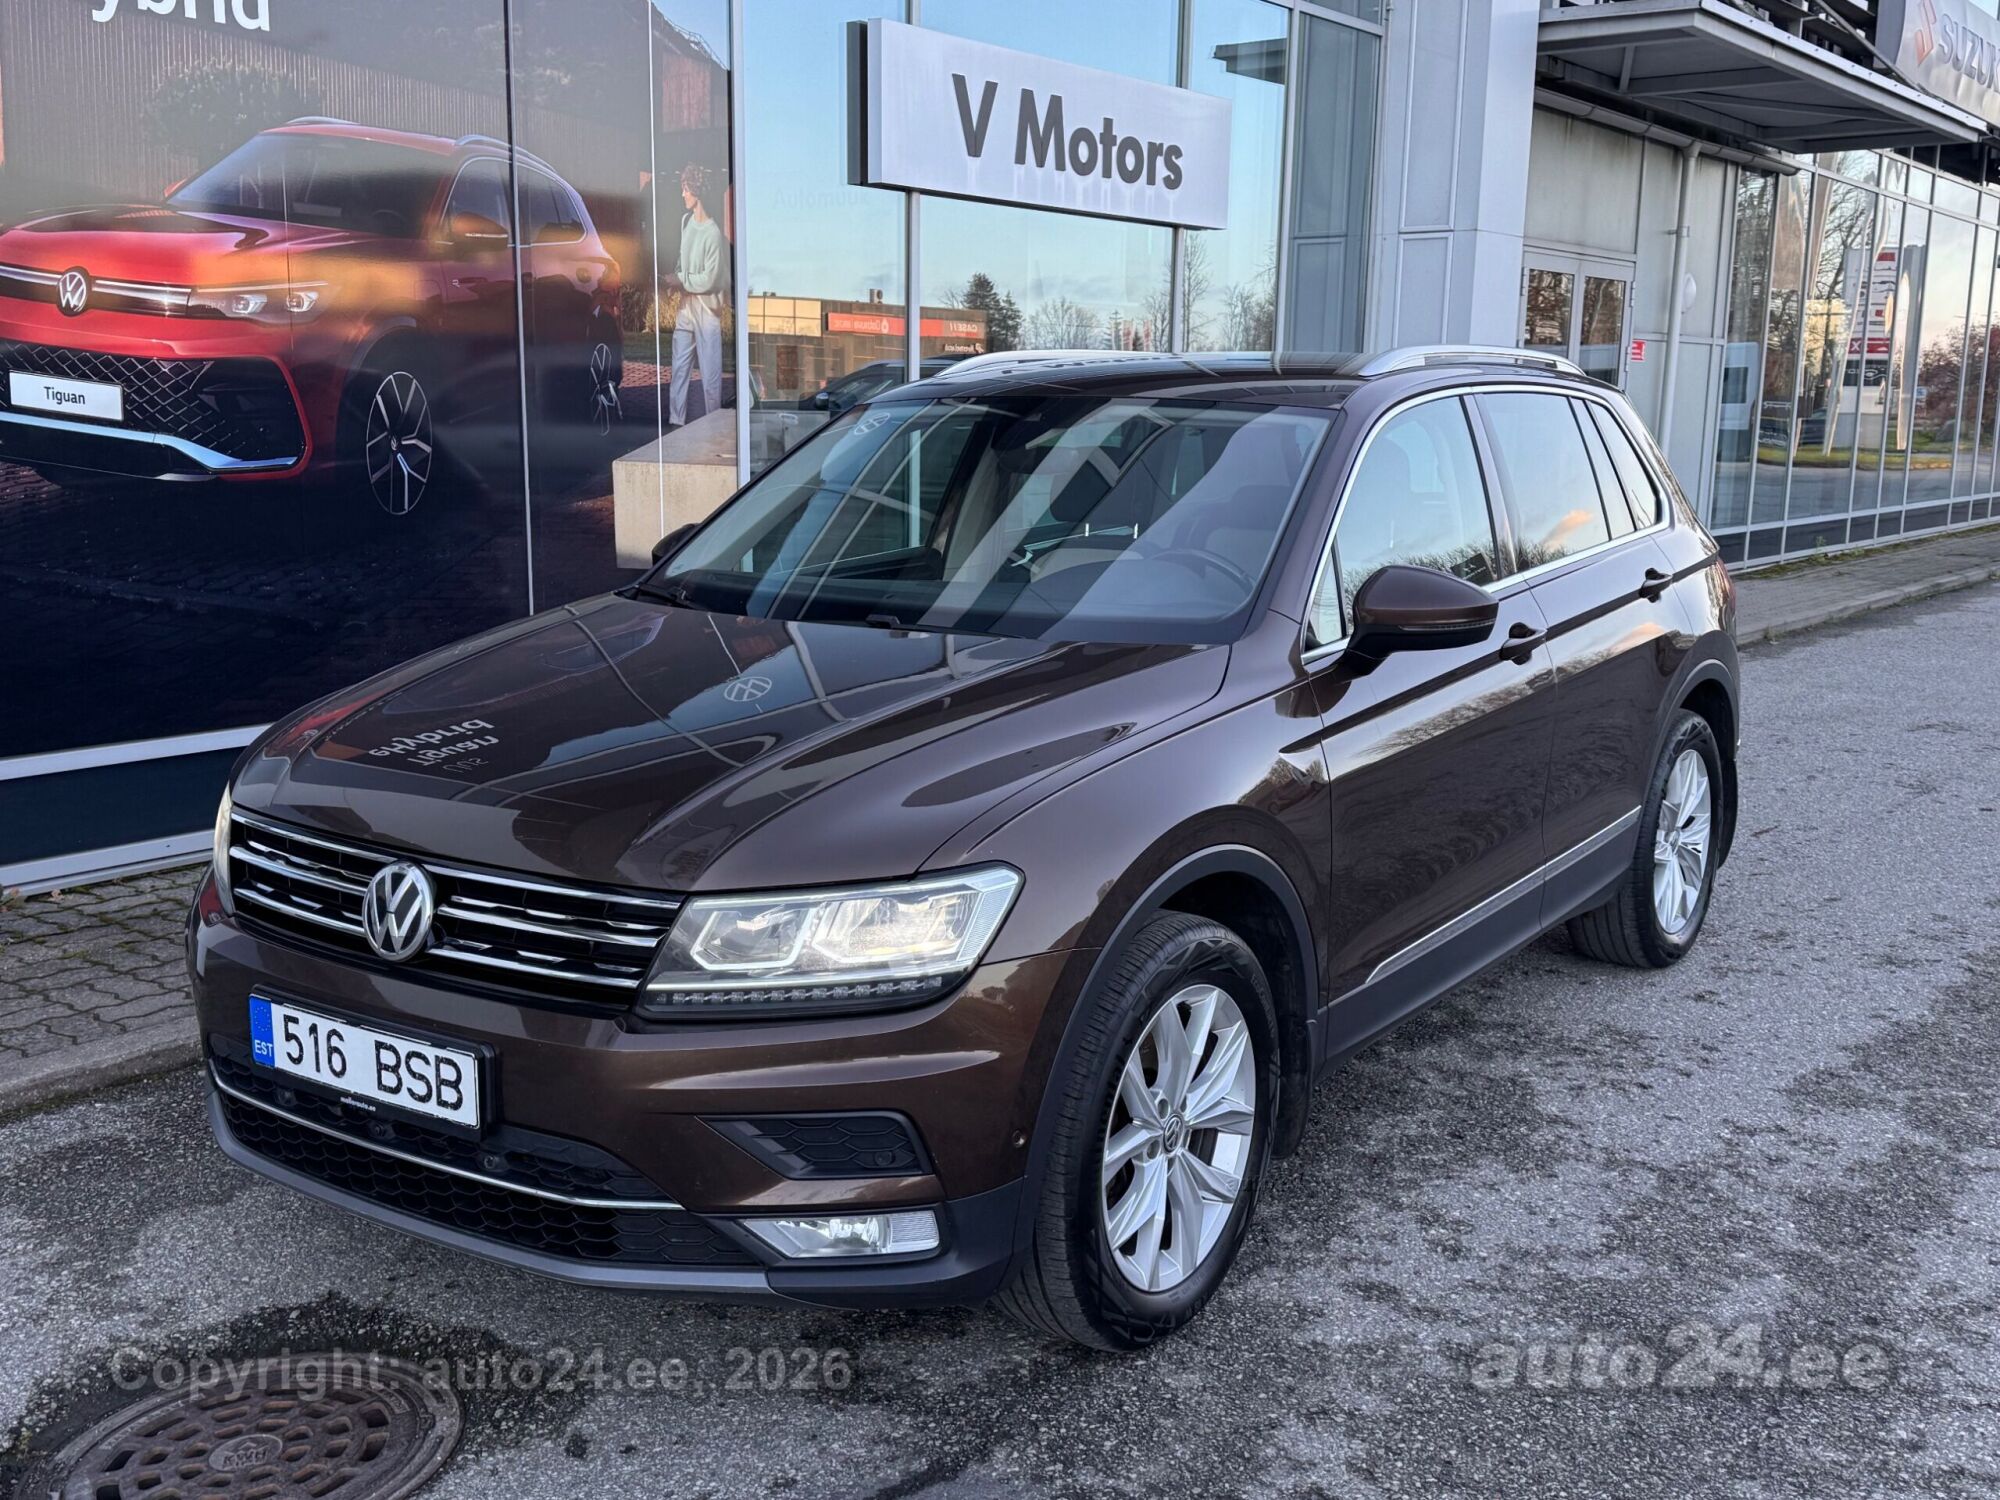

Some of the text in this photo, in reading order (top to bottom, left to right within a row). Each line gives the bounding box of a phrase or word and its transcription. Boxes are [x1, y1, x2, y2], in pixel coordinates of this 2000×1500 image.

[952, 73, 1183, 190] V Motors
[43, 386, 86, 405] Tiguan
[255, 1040, 273, 1057] EST
[283, 1013, 464, 1111] 516 BSB
